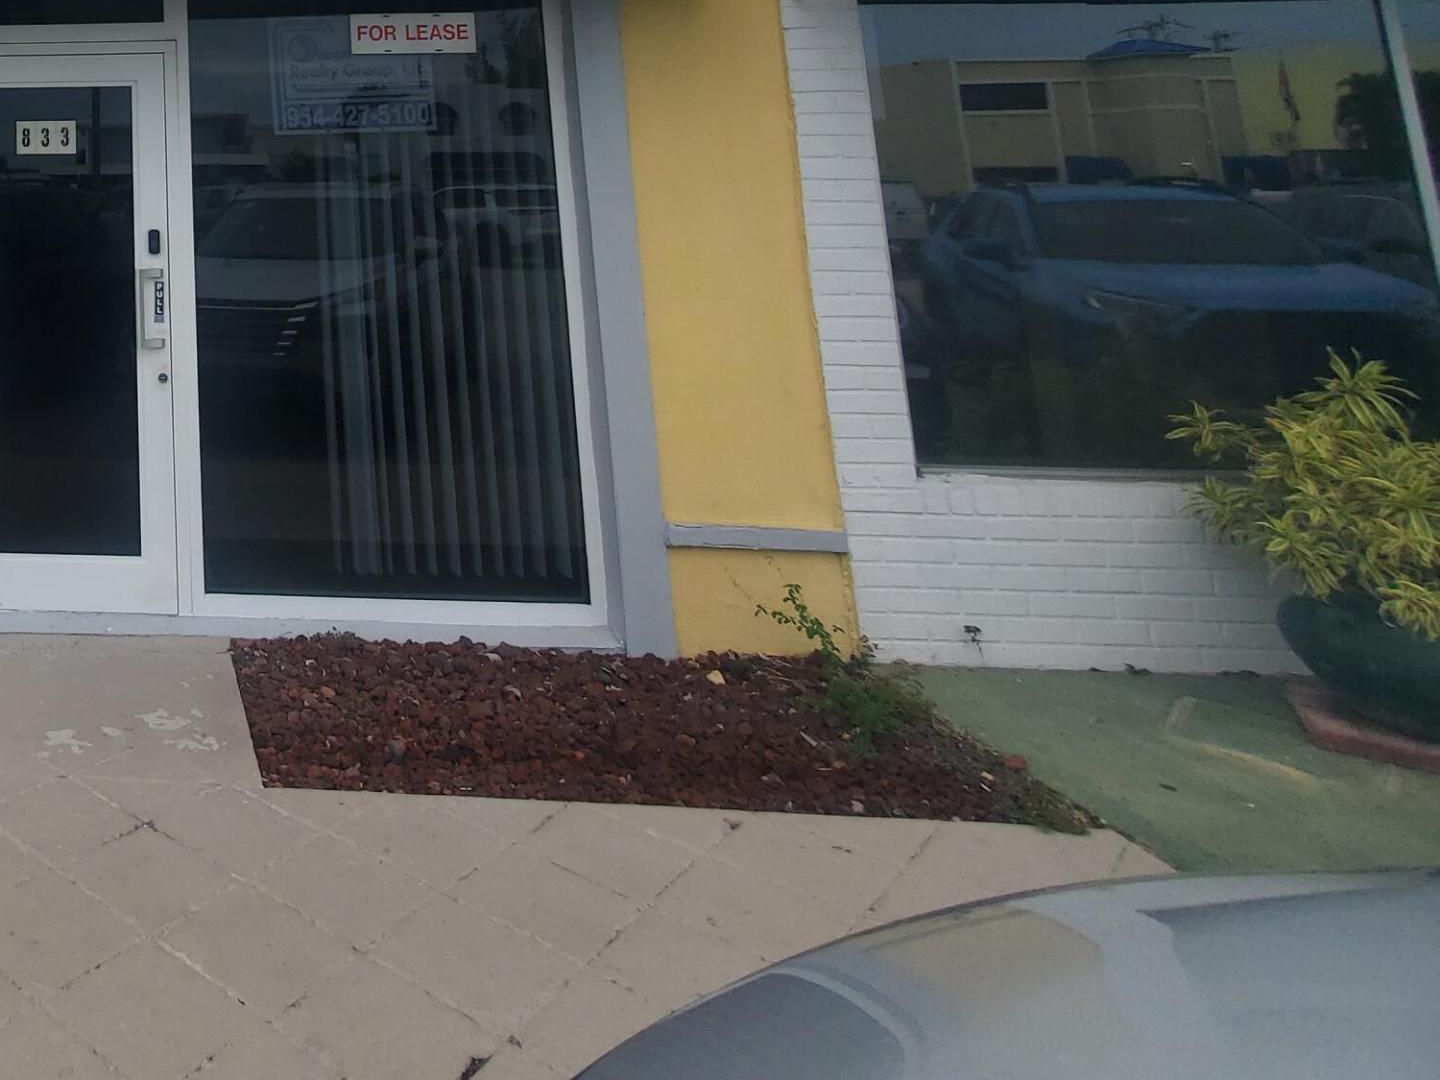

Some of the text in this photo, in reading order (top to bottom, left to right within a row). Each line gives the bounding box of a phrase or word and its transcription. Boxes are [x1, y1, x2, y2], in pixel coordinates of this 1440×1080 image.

[356, 23, 469, 42] FOR LEASE
[286, 102, 431, 129] 954-427-5100
[21, 126, 71, 147] 833
[156, 282, 164, 314] PULL
